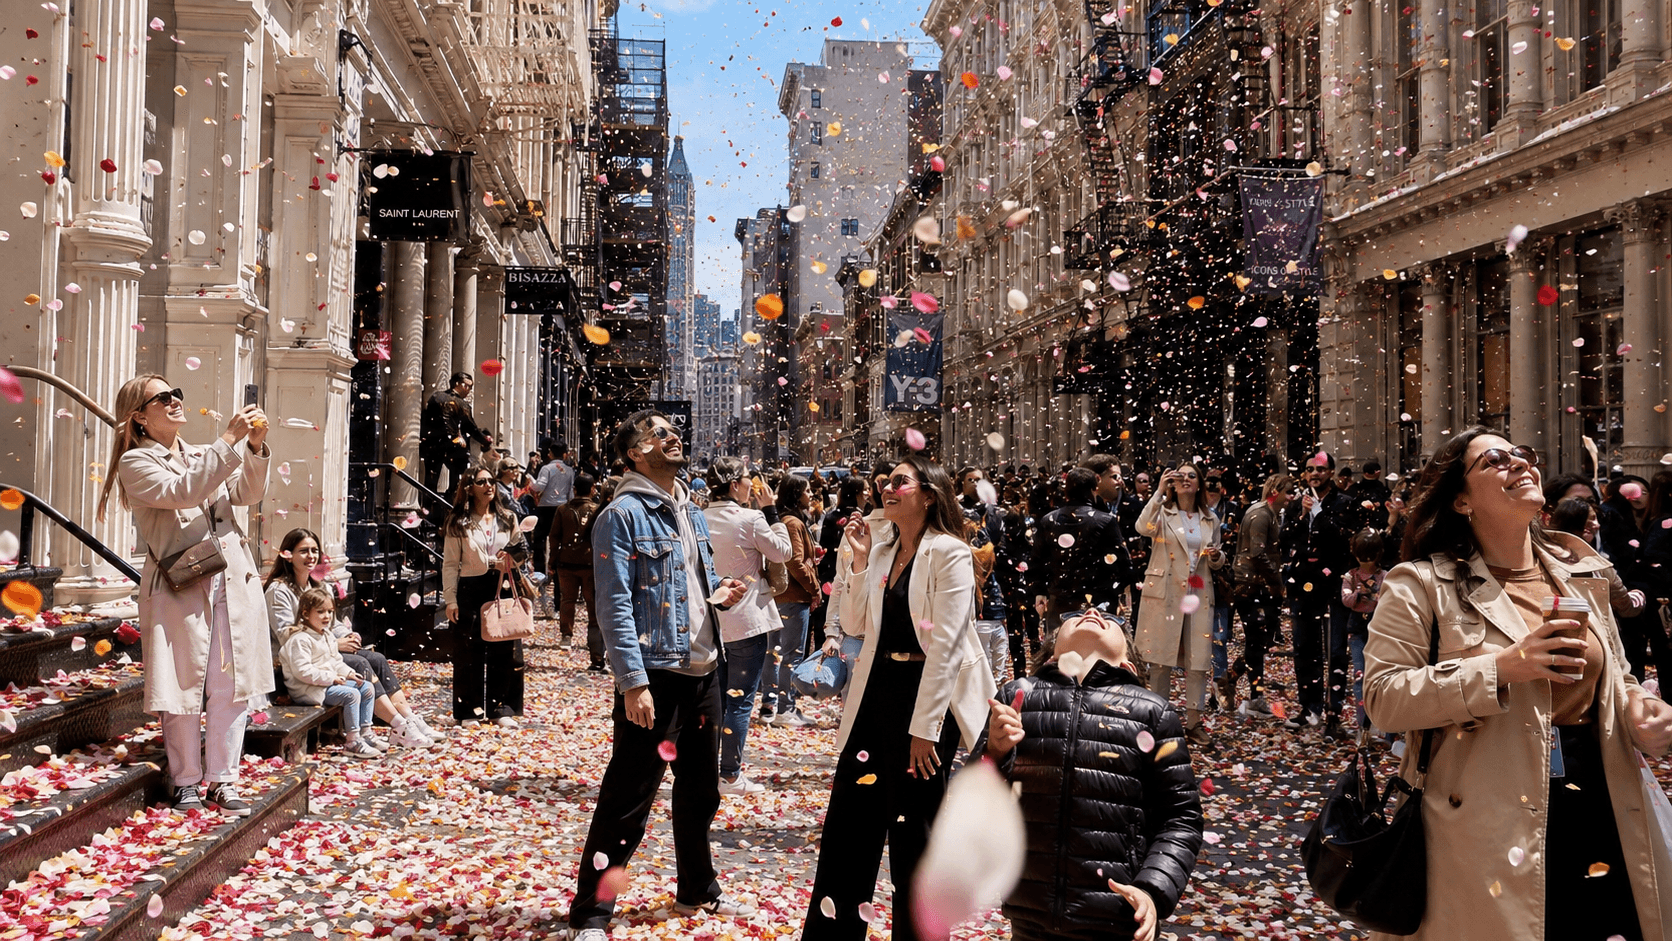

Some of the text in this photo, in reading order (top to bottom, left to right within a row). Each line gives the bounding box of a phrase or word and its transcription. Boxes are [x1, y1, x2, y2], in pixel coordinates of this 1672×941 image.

[379, 208, 460, 219] SAINT LAURENT
[508, 272, 567, 284] BISAZZA
[888, 374, 938, 405] Y-3
